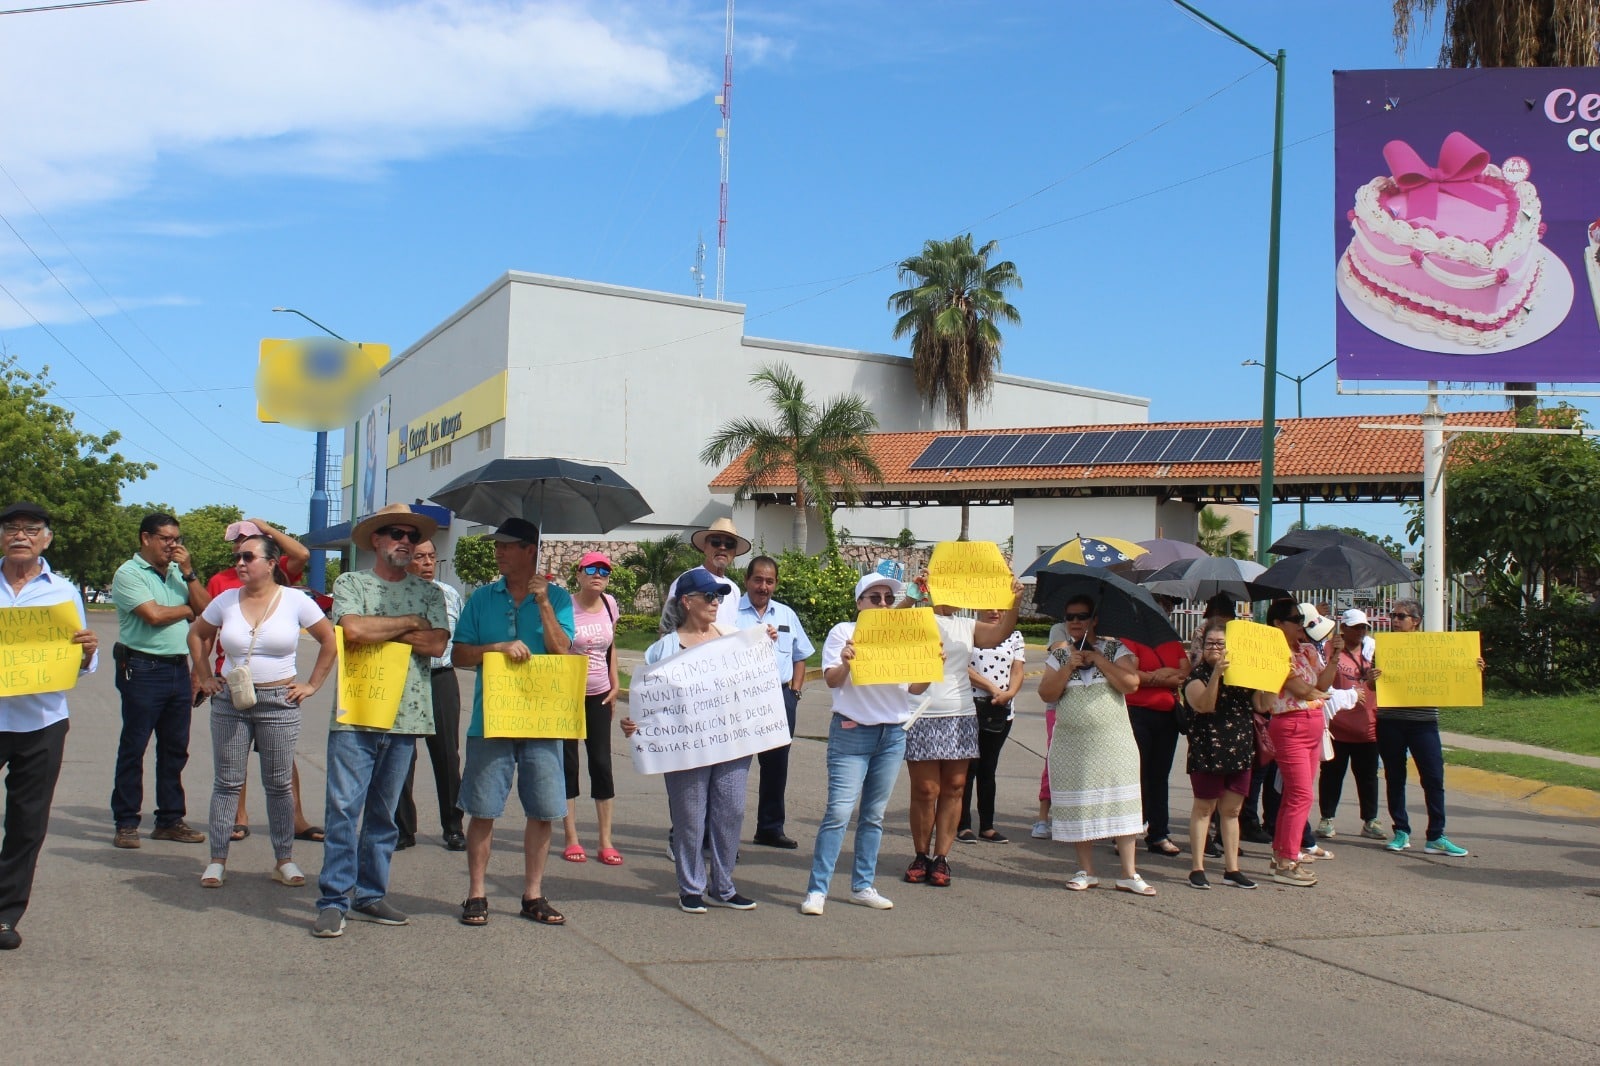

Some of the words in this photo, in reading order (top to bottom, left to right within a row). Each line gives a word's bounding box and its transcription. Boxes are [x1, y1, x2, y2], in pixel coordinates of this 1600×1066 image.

[872, 610, 924, 626] JUMAPAM
[0, 628, 27, 646] OS
[36, 626, 70, 642] SIN
[853, 628, 896, 645] QUITAR
[899, 628, 928, 642] AGUA
[4, 648, 48, 667] DESDE
[56, 647, 70, 661] EL
[904, 645, 938, 661] VITAL
[721, 655, 729, 671] A
[855, 663, 873, 679] ES
[874, 663, 890, 678] UN
[894, 662, 935, 678] DELITO
[37, 668, 51, 686] 16
[361, 664, 385, 681] QUE
[368, 683, 389, 701] DEL
[550, 678, 566, 694] AL
[553, 697, 579, 713] CON
[642, 707, 656, 718] DE
[663, 704, 688, 717] AGUA
[693, 696, 730, 715] POTABLE
[733, 690, 740, 703] A
[729, 712, 742, 725] DE
[746, 704, 774, 720] DEUDA
[537, 717, 552, 732] DE
[647, 738, 691, 753] QUITAR
[693, 738, 706, 750] EL
[709, 727, 751, 746] MEDIDOR
